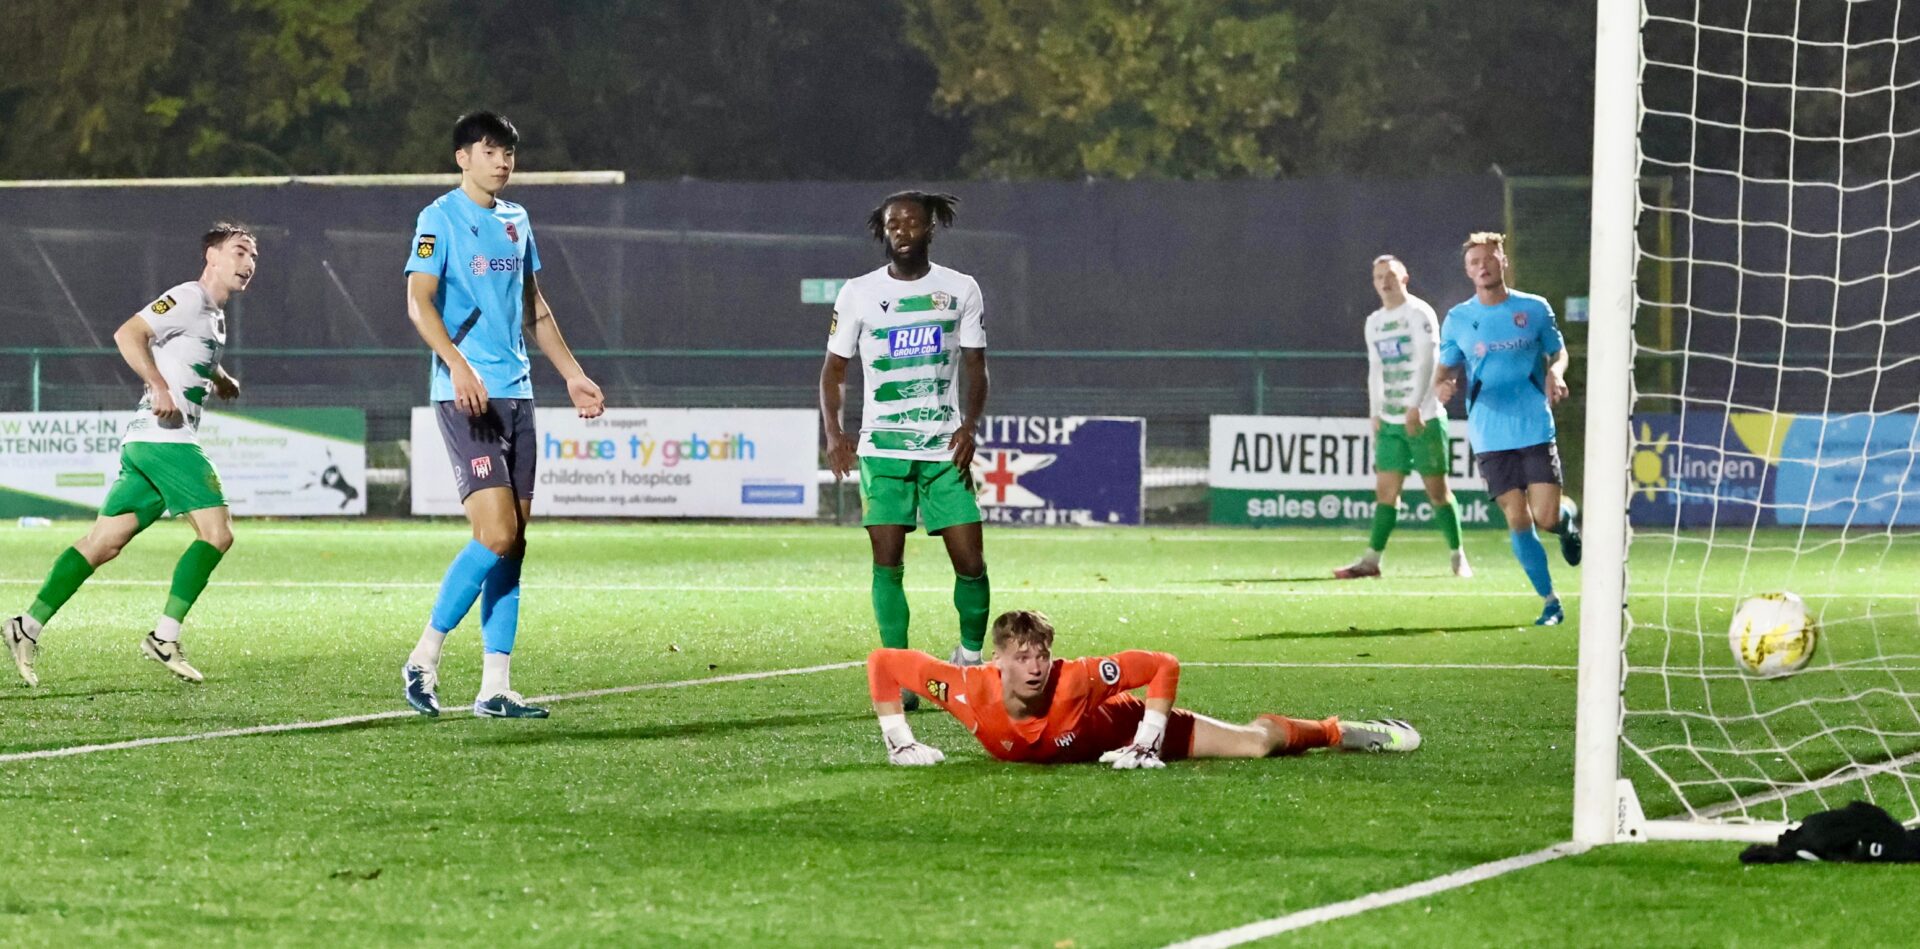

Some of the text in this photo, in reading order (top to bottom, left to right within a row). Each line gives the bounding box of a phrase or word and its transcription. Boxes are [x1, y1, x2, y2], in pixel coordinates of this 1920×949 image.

[894, 326, 938, 349] RUK
[893, 345, 938, 357] GROUP.COM
[28, 420, 117, 434] WALK-IN
[0, 438, 121, 454] TENING SER
[1231, 432, 1370, 475] ADVERTI
[540, 470, 692, 488] children's hospices
[1668, 454, 1755, 486] Lingen
